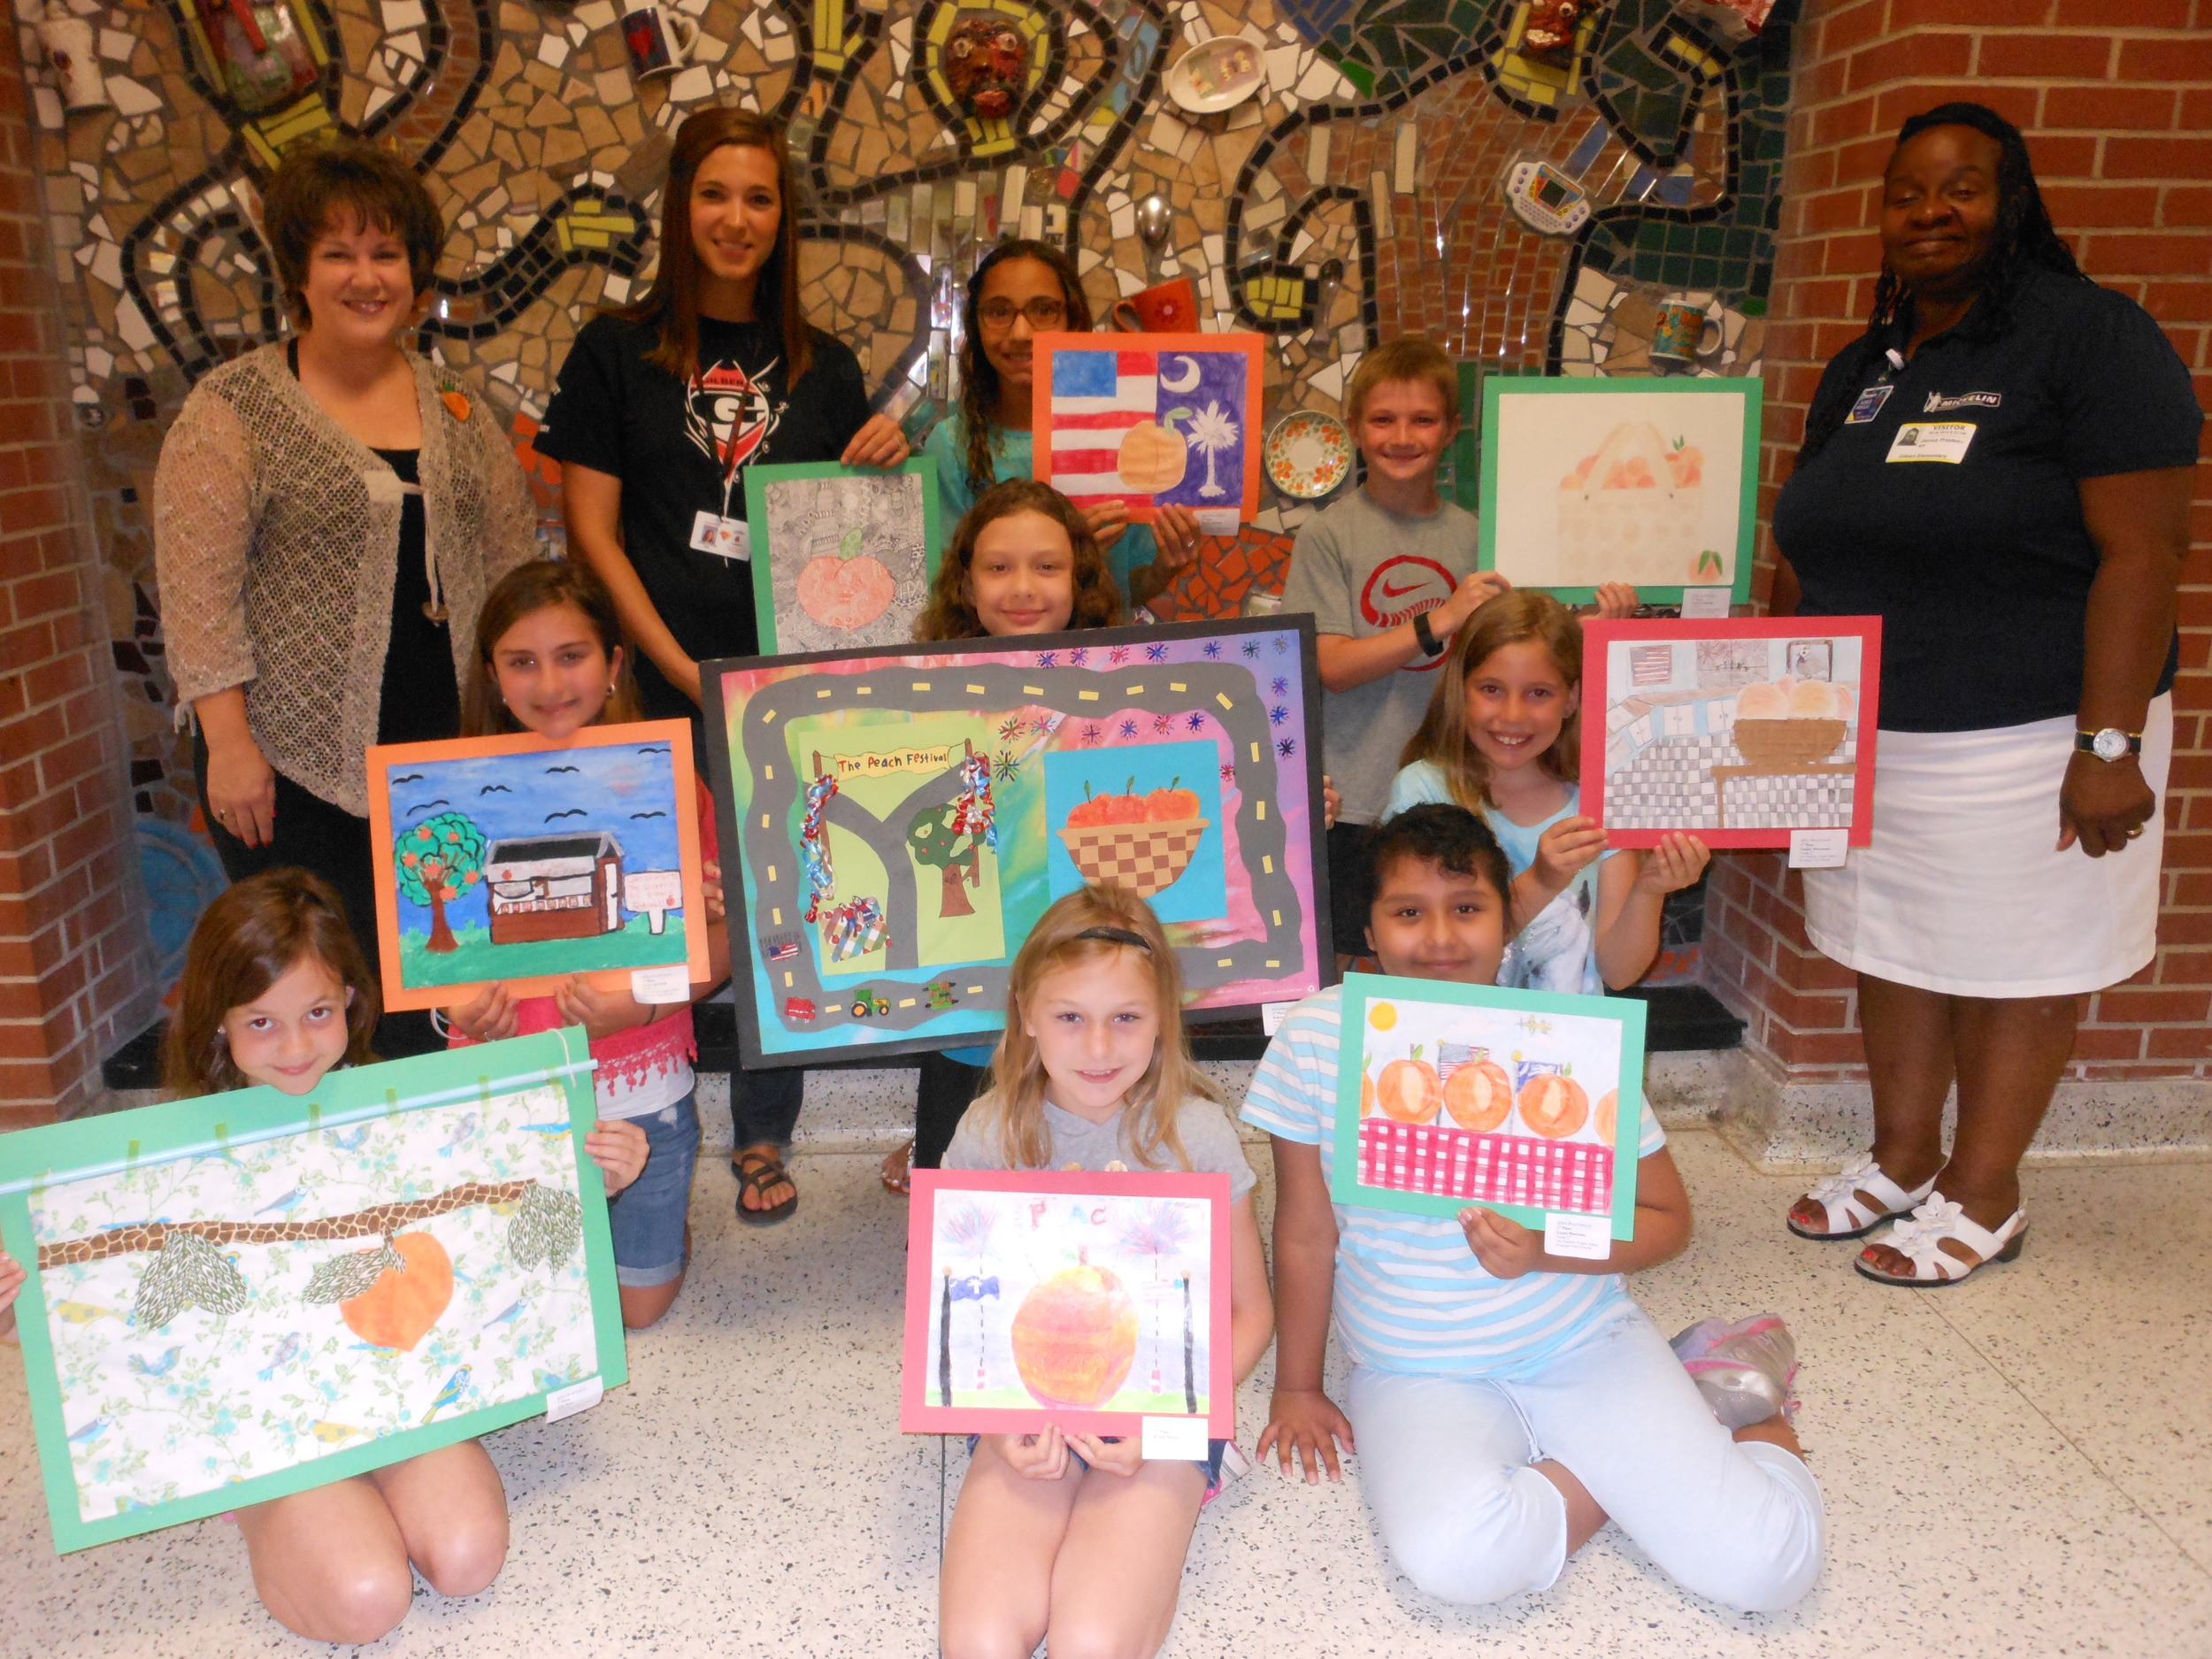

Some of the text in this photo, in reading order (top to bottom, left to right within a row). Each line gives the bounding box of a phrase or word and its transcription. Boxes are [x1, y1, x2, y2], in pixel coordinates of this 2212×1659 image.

[838, 753, 948, 772] The Peach Festival
